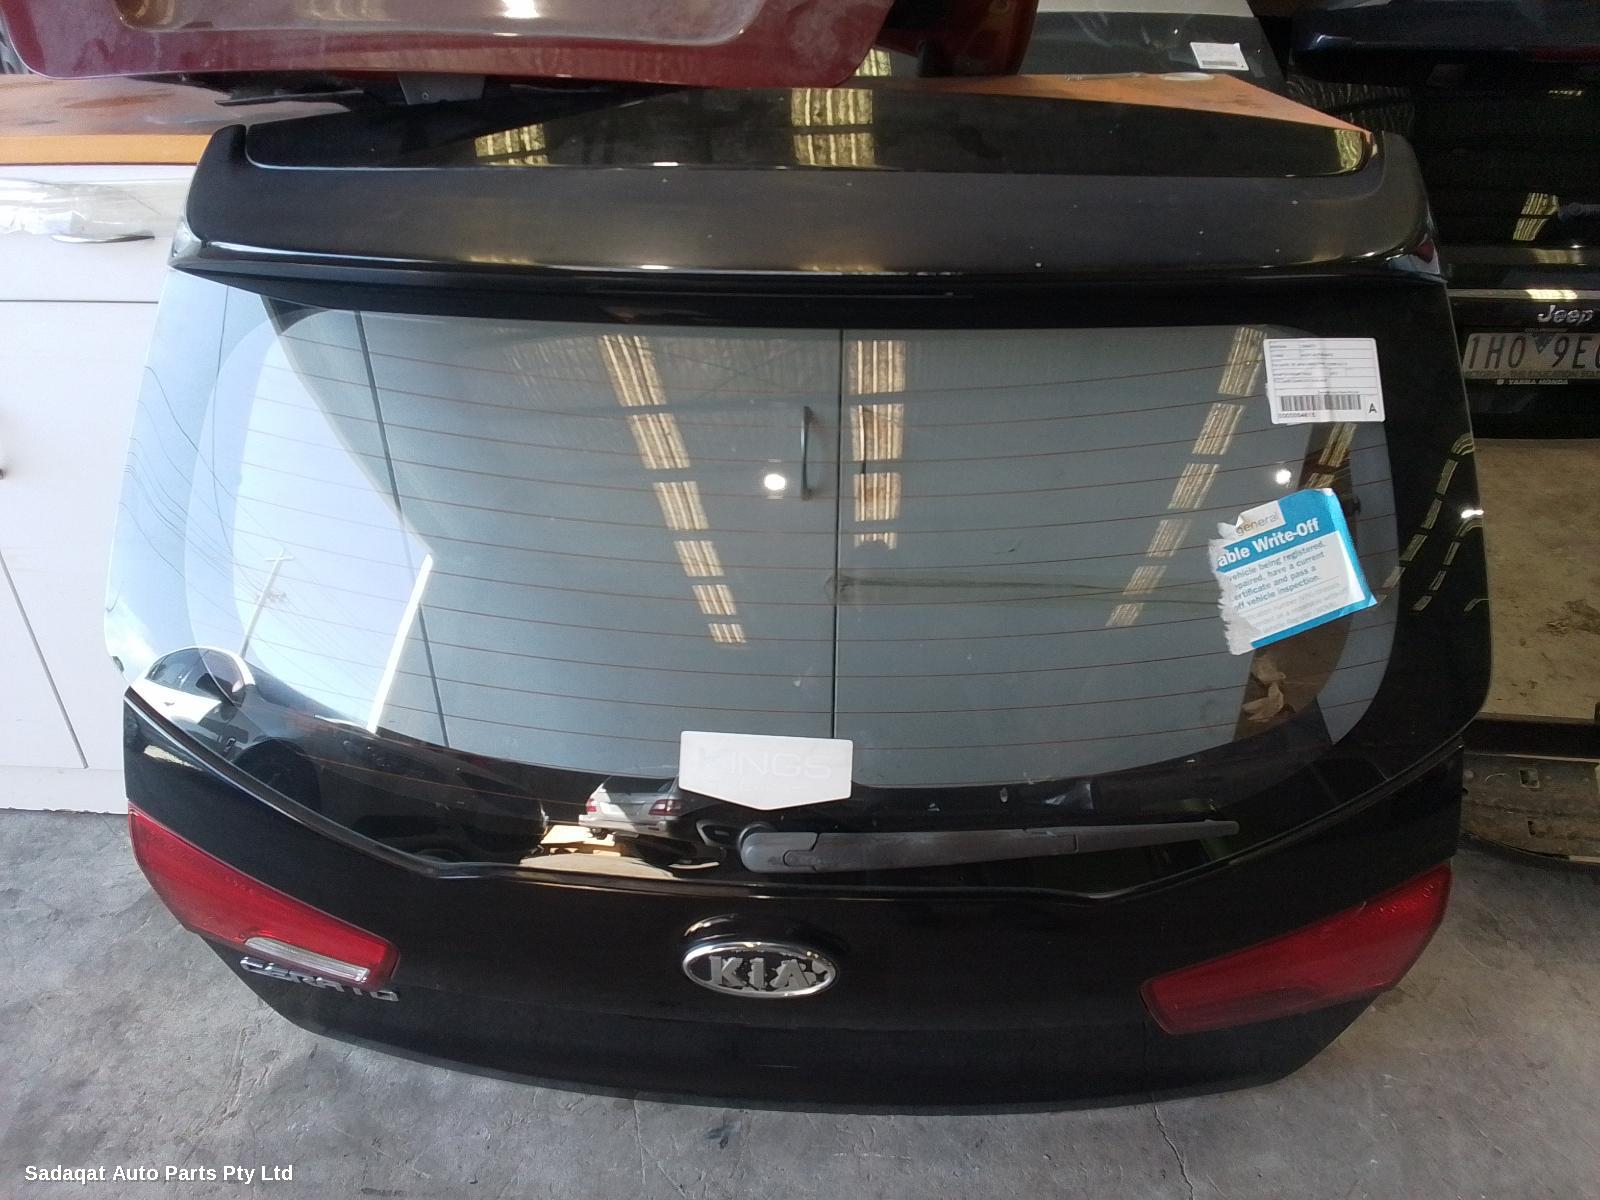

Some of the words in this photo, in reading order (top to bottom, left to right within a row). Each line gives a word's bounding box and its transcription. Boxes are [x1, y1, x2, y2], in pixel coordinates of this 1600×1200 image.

[1537, 304, 1593, 326] Jeep
[1368, 402, 1378, 414] A
[1235, 512, 1279, 536] general
[1218, 546, 1251, 567] able
[1252, 517, 1320, 553] Write-Off
[1258, 557, 1282, 572] being
[1267, 566, 1287, 577] have
[1289, 562, 1295, 570] a
[1296, 551, 1325, 567] current
[1232, 583, 1272, 601] ertificate
[1274, 575, 1288, 586] and
[1290, 568, 1308, 581] pass
[1247, 590, 1276, 606] vehicle
[699, 746, 833, 779] INGS
[708, 955, 810, 991] KIA
